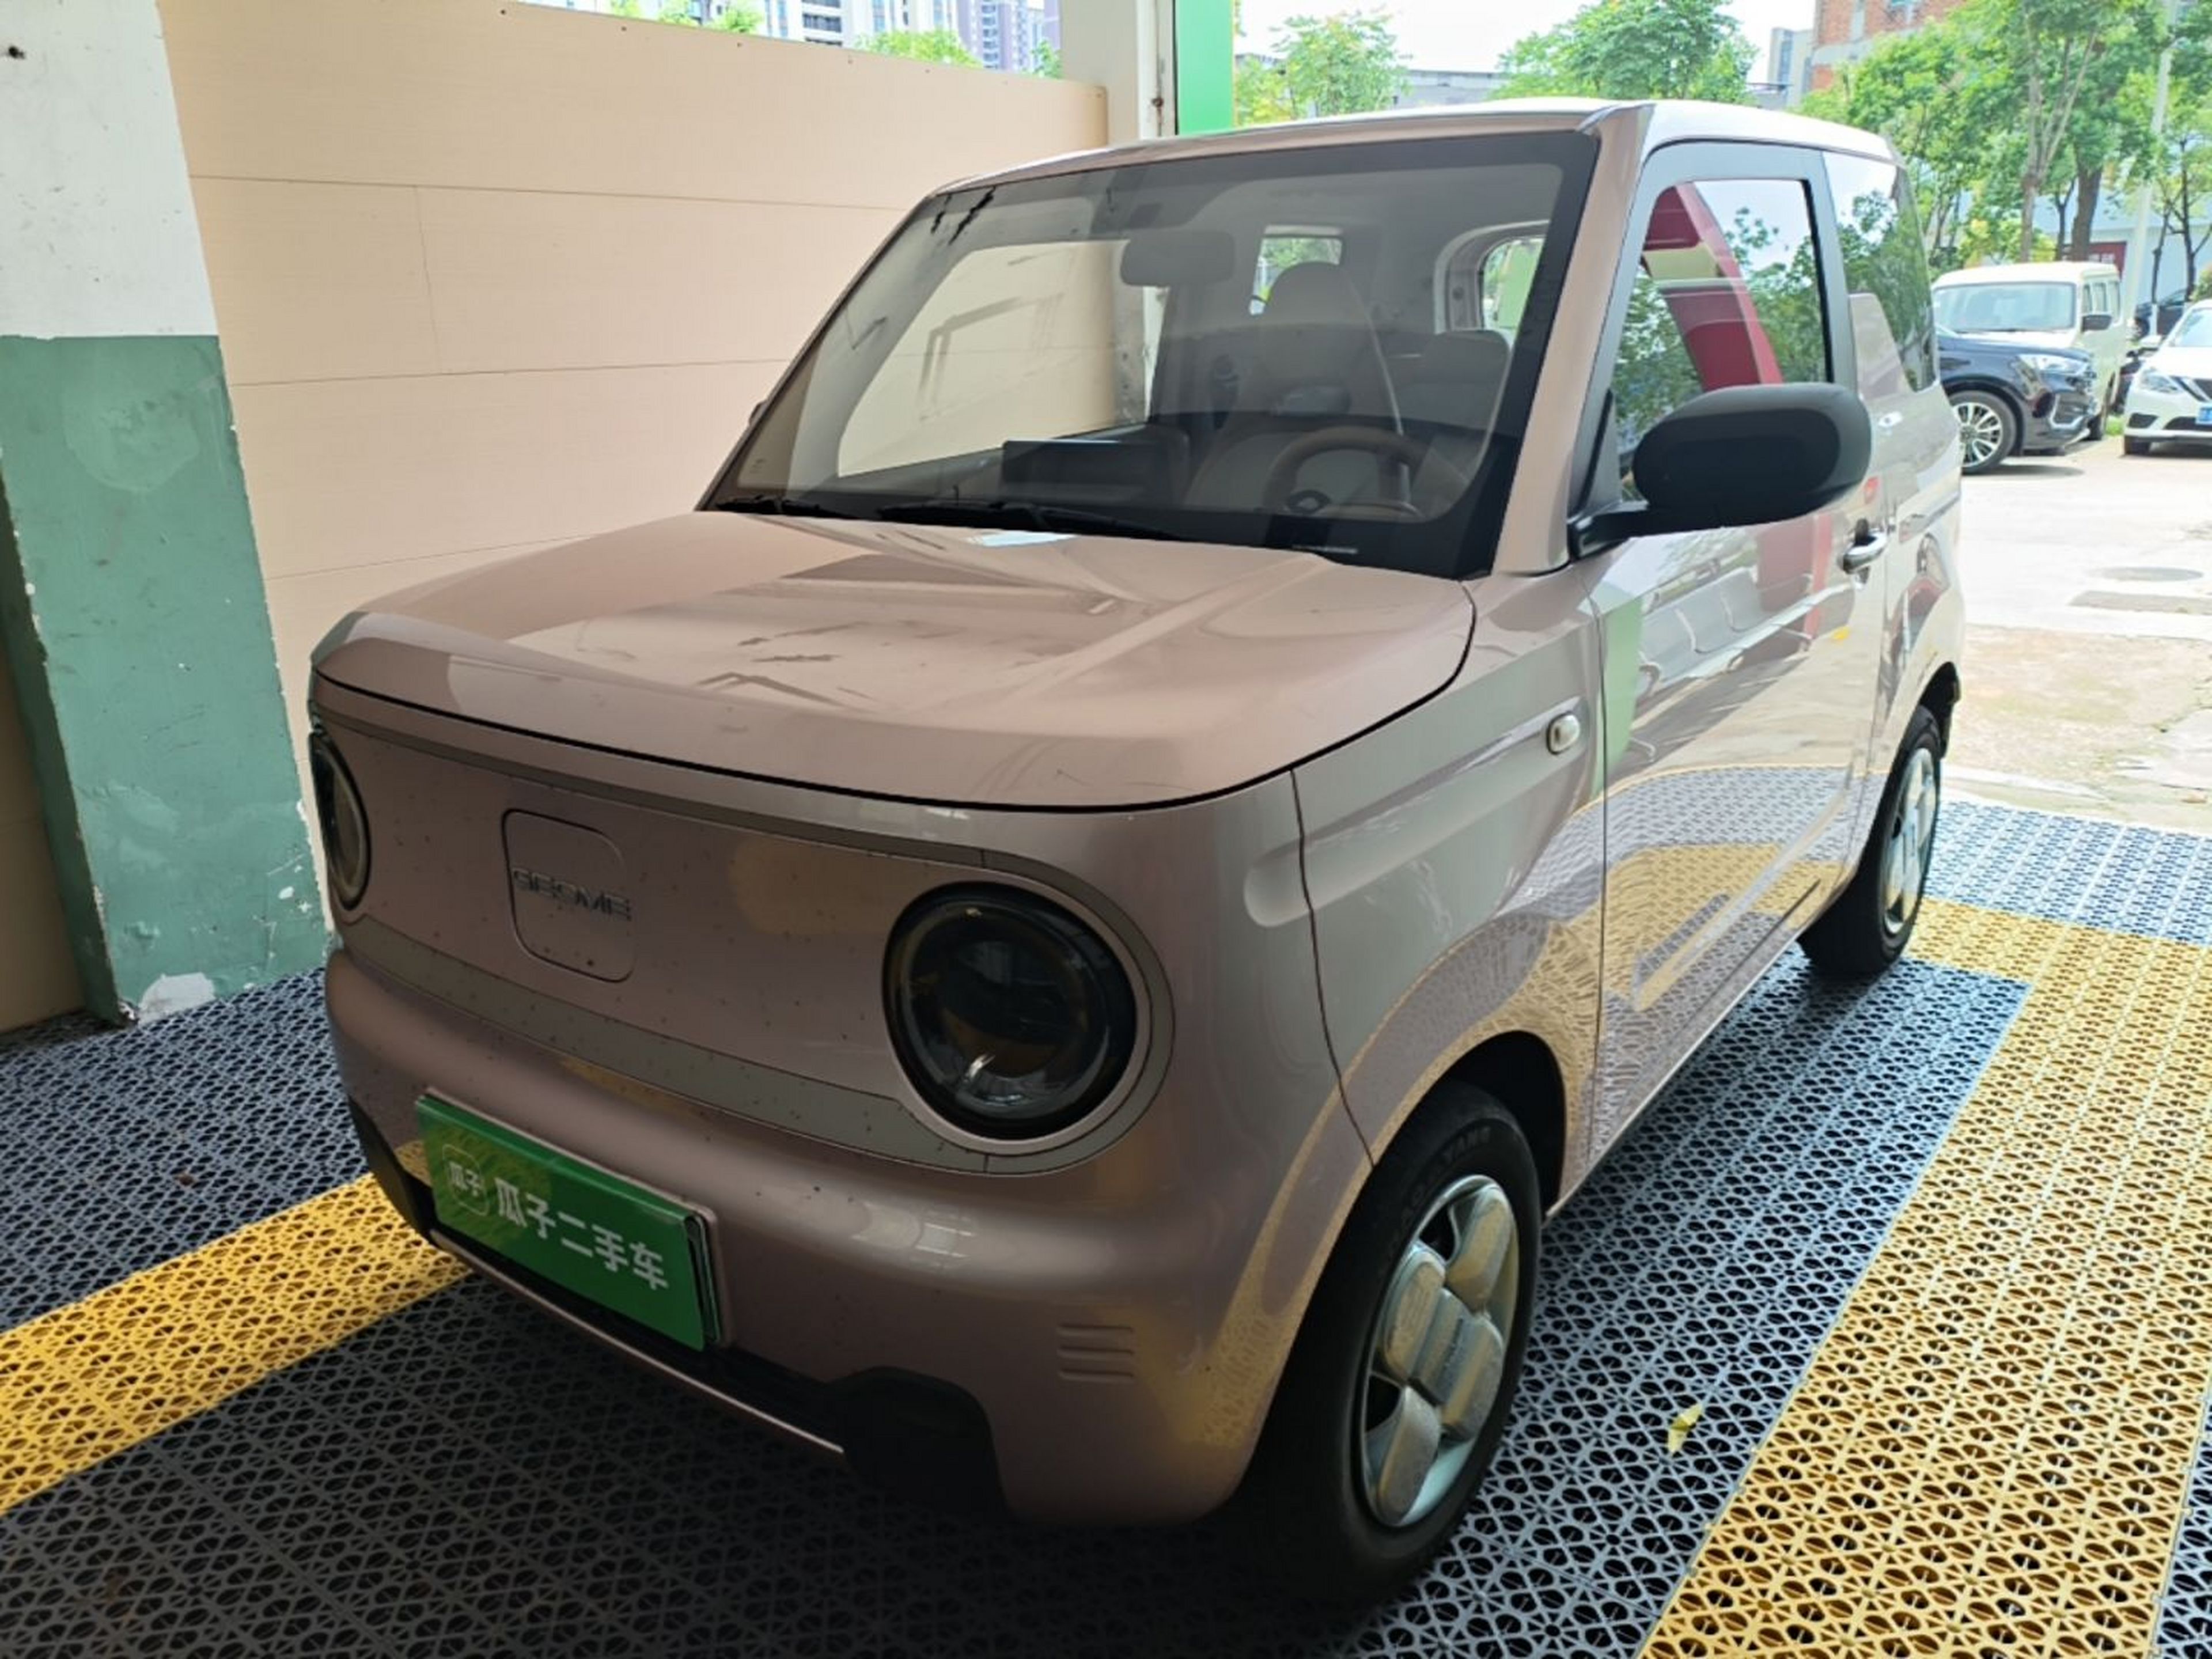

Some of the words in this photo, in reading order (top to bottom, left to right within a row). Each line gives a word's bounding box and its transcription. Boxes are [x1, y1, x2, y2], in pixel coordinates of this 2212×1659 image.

[448, 1160, 486, 1198] 瓜子
[494, 1176, 670, 1291] 瓜子二手车
